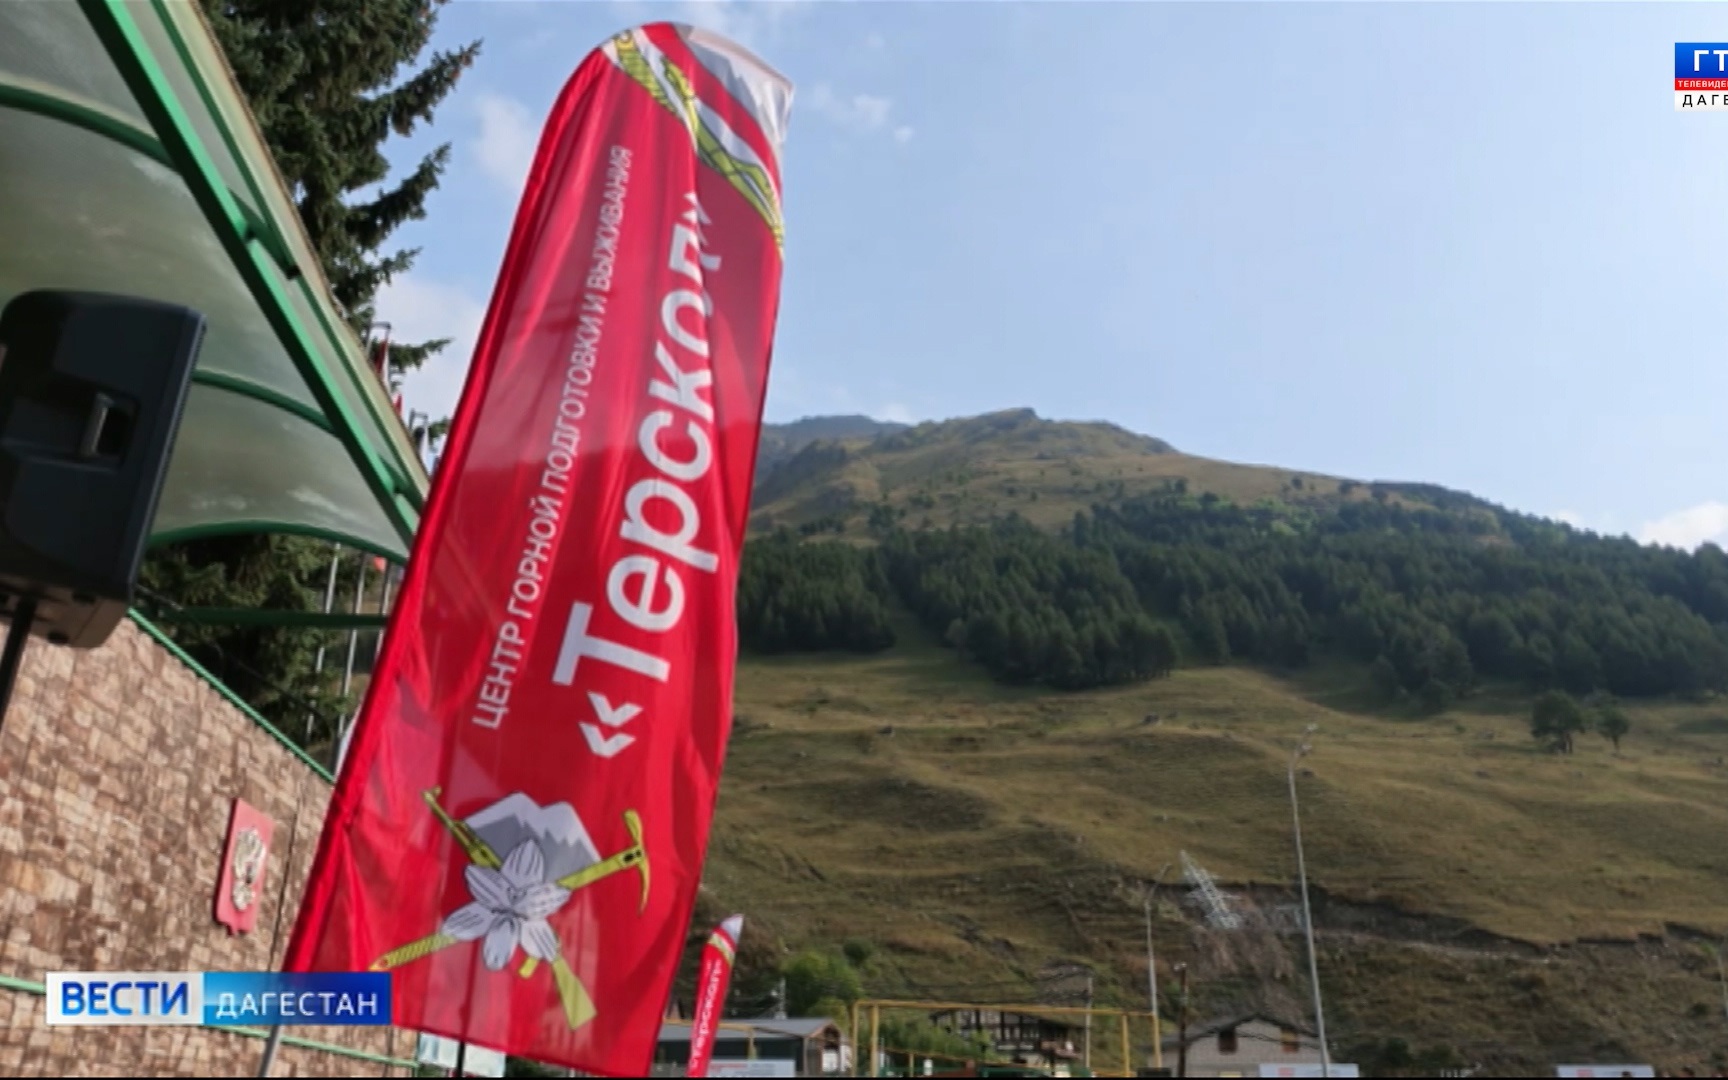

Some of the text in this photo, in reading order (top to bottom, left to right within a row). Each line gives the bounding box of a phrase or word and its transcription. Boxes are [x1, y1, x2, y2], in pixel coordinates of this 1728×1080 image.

[471, 145, 633, 730] ЦЕНТР ГОРНОЙ ПОДГОТОВКИ И ВЫЖИВАНИЯ
